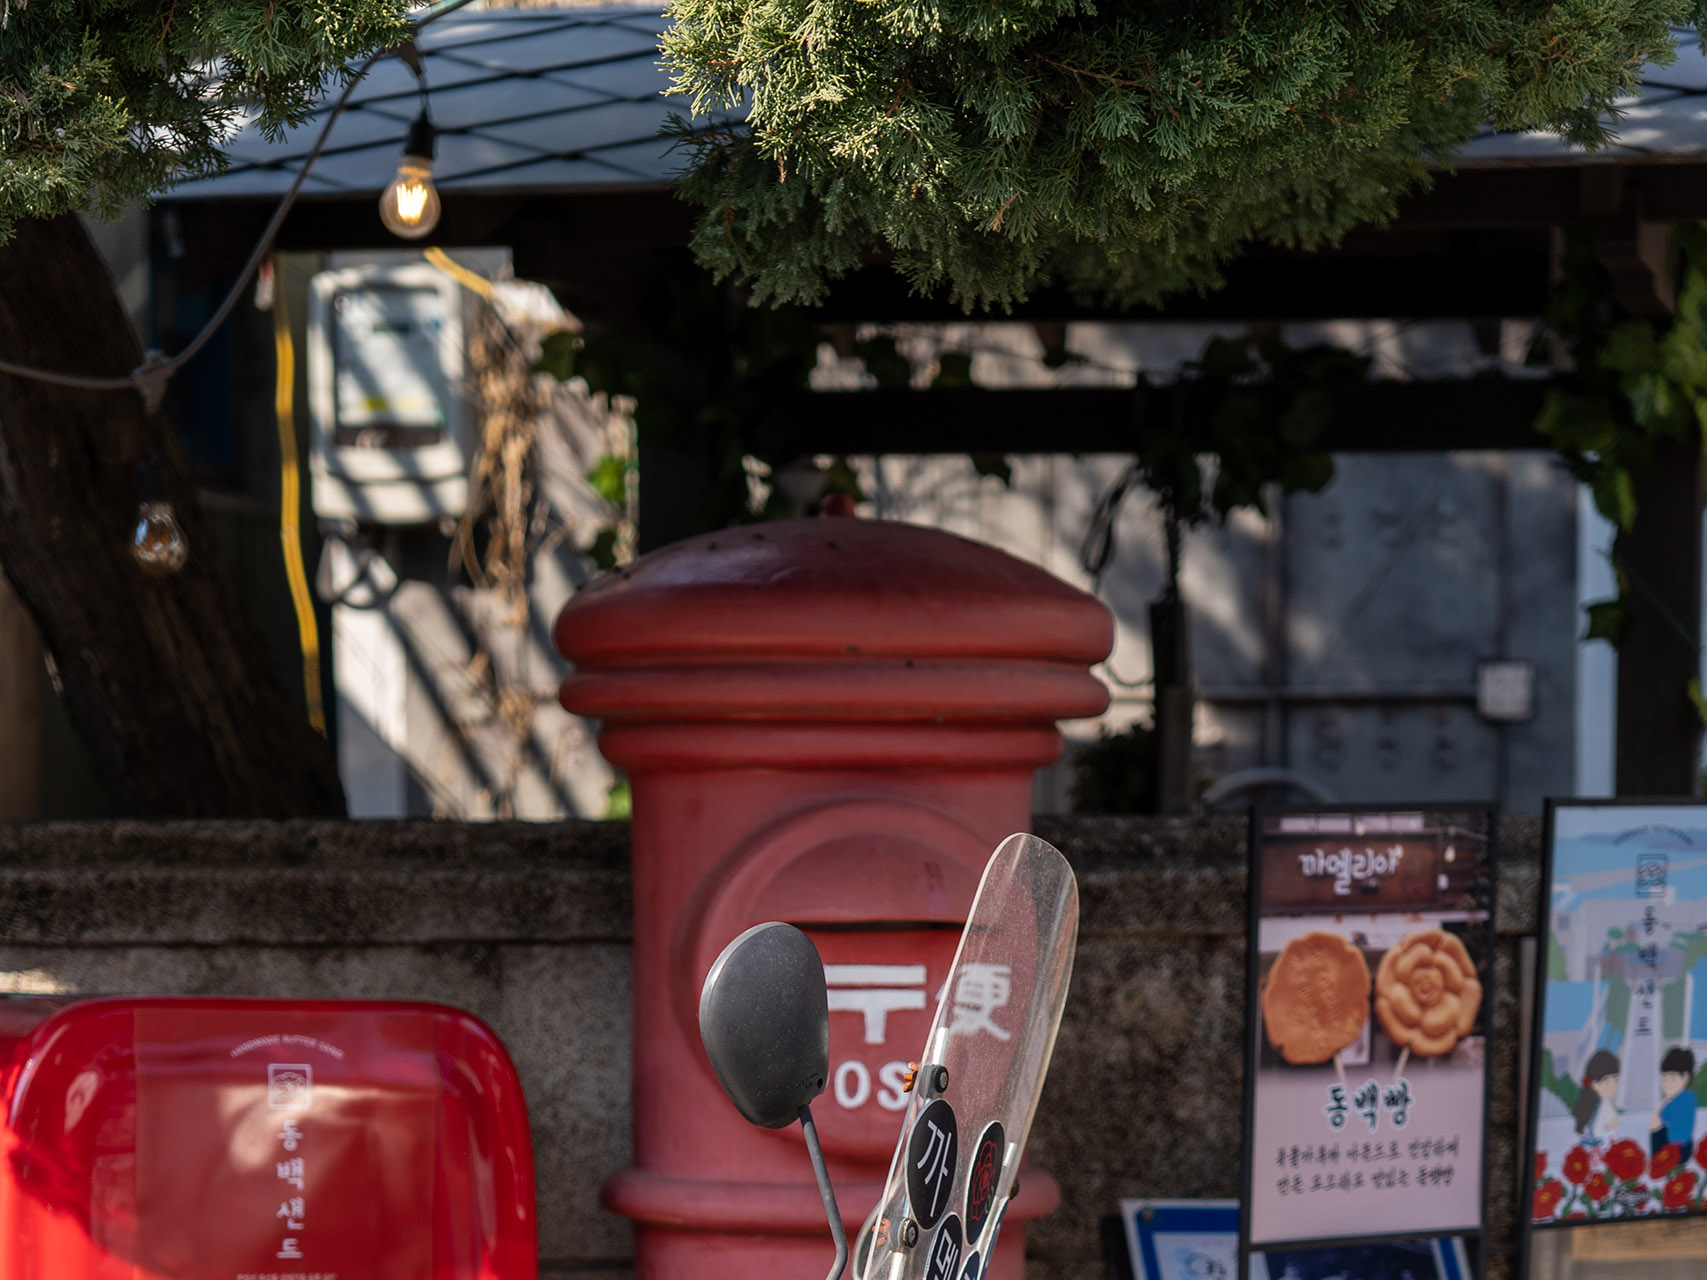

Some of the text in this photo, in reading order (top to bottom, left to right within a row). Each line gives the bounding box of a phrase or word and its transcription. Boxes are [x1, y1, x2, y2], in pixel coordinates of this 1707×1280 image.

[1298, 848, 1399, 896] 까멜리아
[1327, 1081, 1413, 1130] 동백빵
[276, 1118, 305, 1259] 동백샌드
